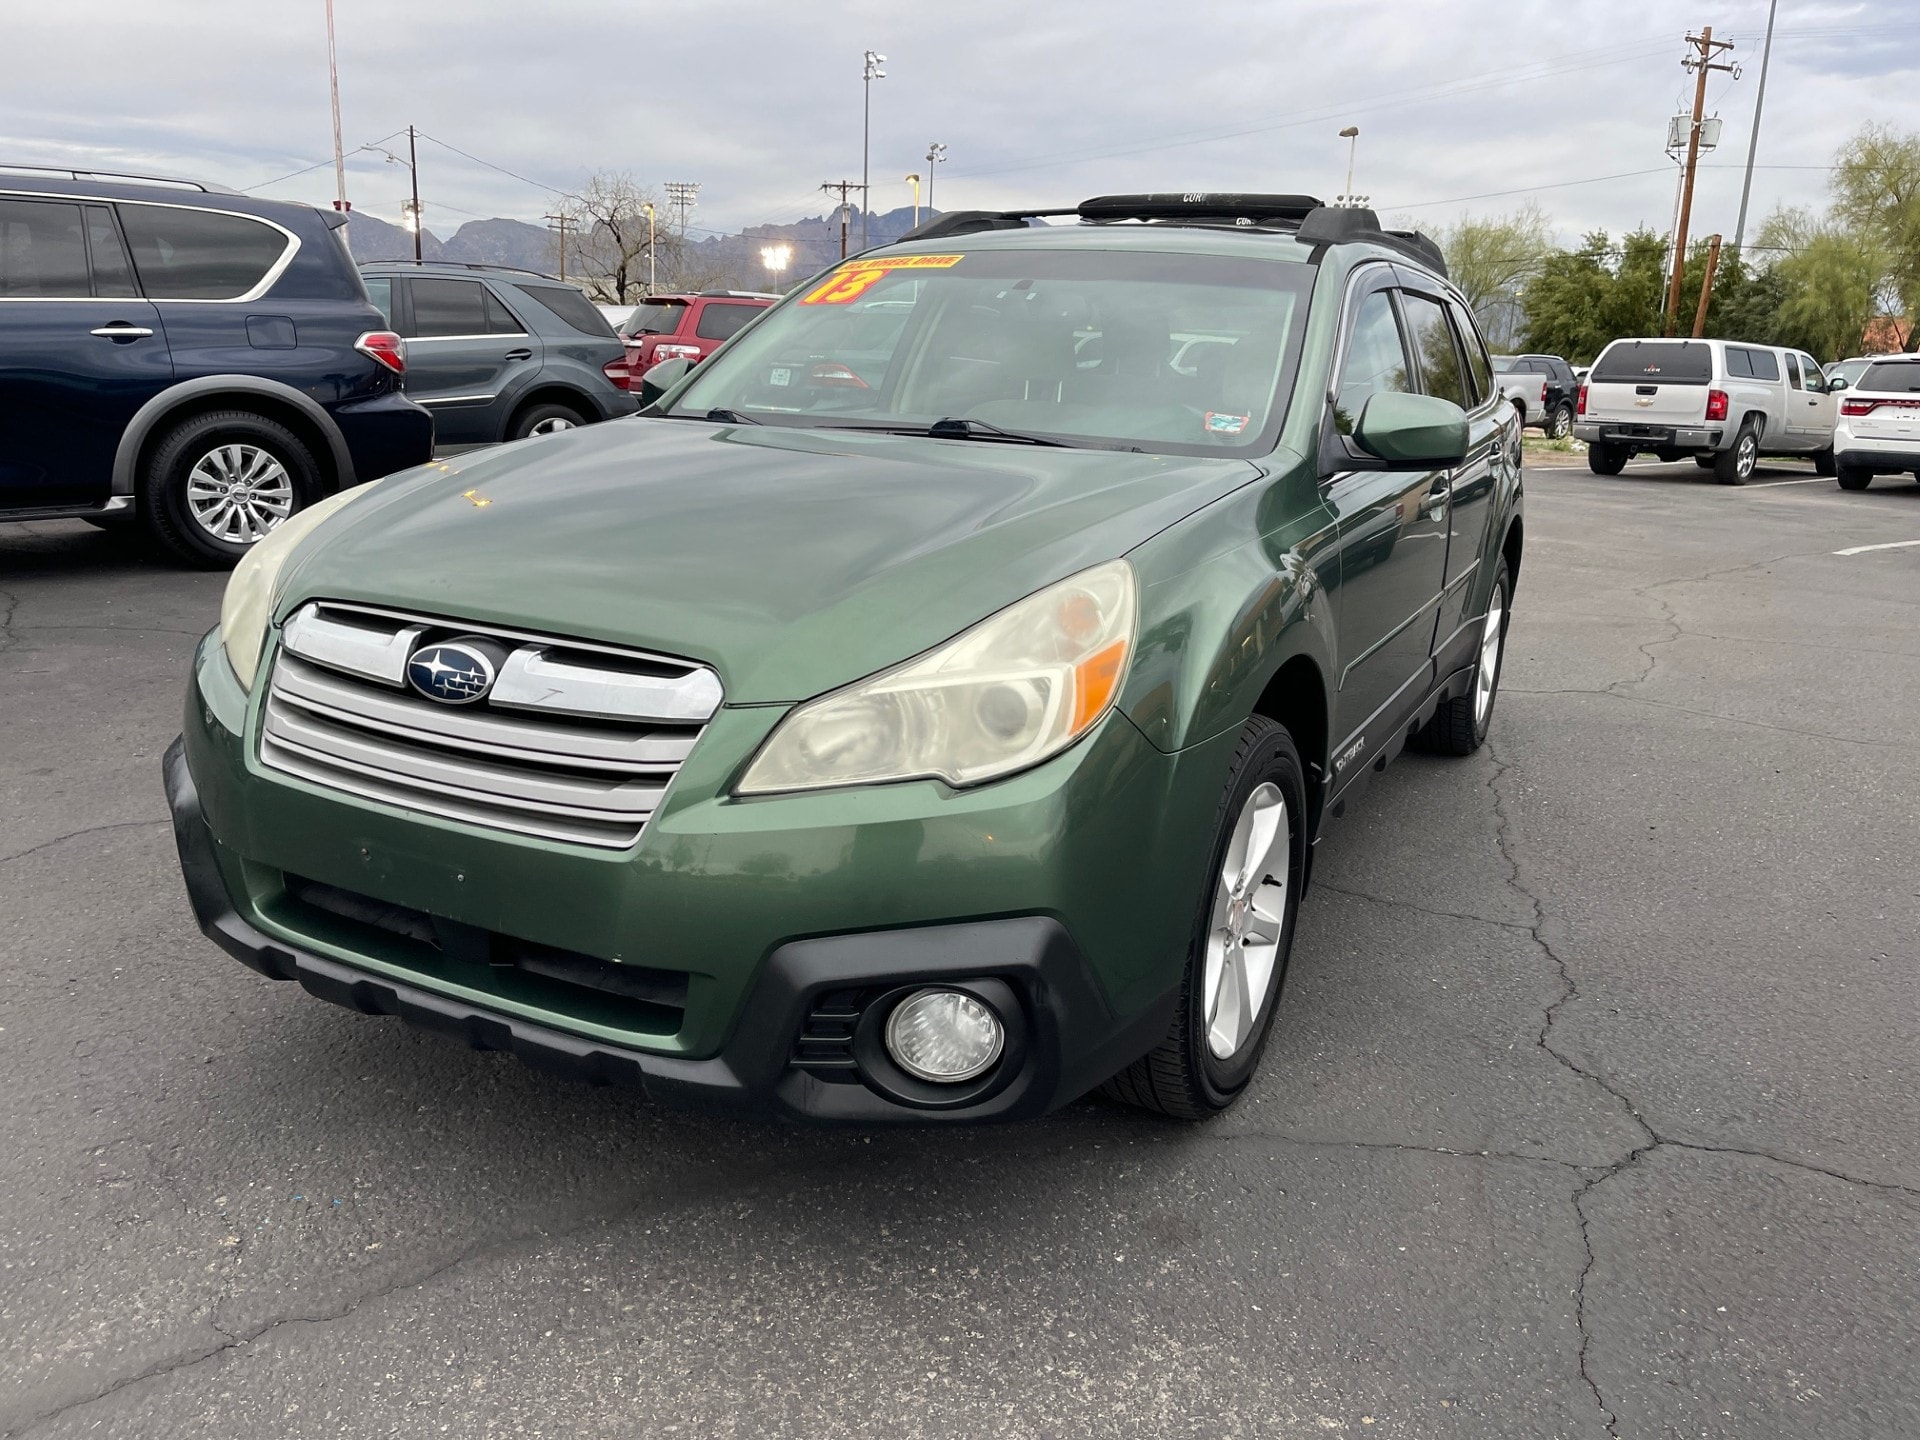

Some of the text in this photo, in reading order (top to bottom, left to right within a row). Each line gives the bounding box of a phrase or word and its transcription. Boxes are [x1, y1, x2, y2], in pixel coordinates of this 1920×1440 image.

[867, 258, 914, 268] WHEEL
[912, 256, 959, 265] DRIVE
[803, 270, 884, 303] 13
